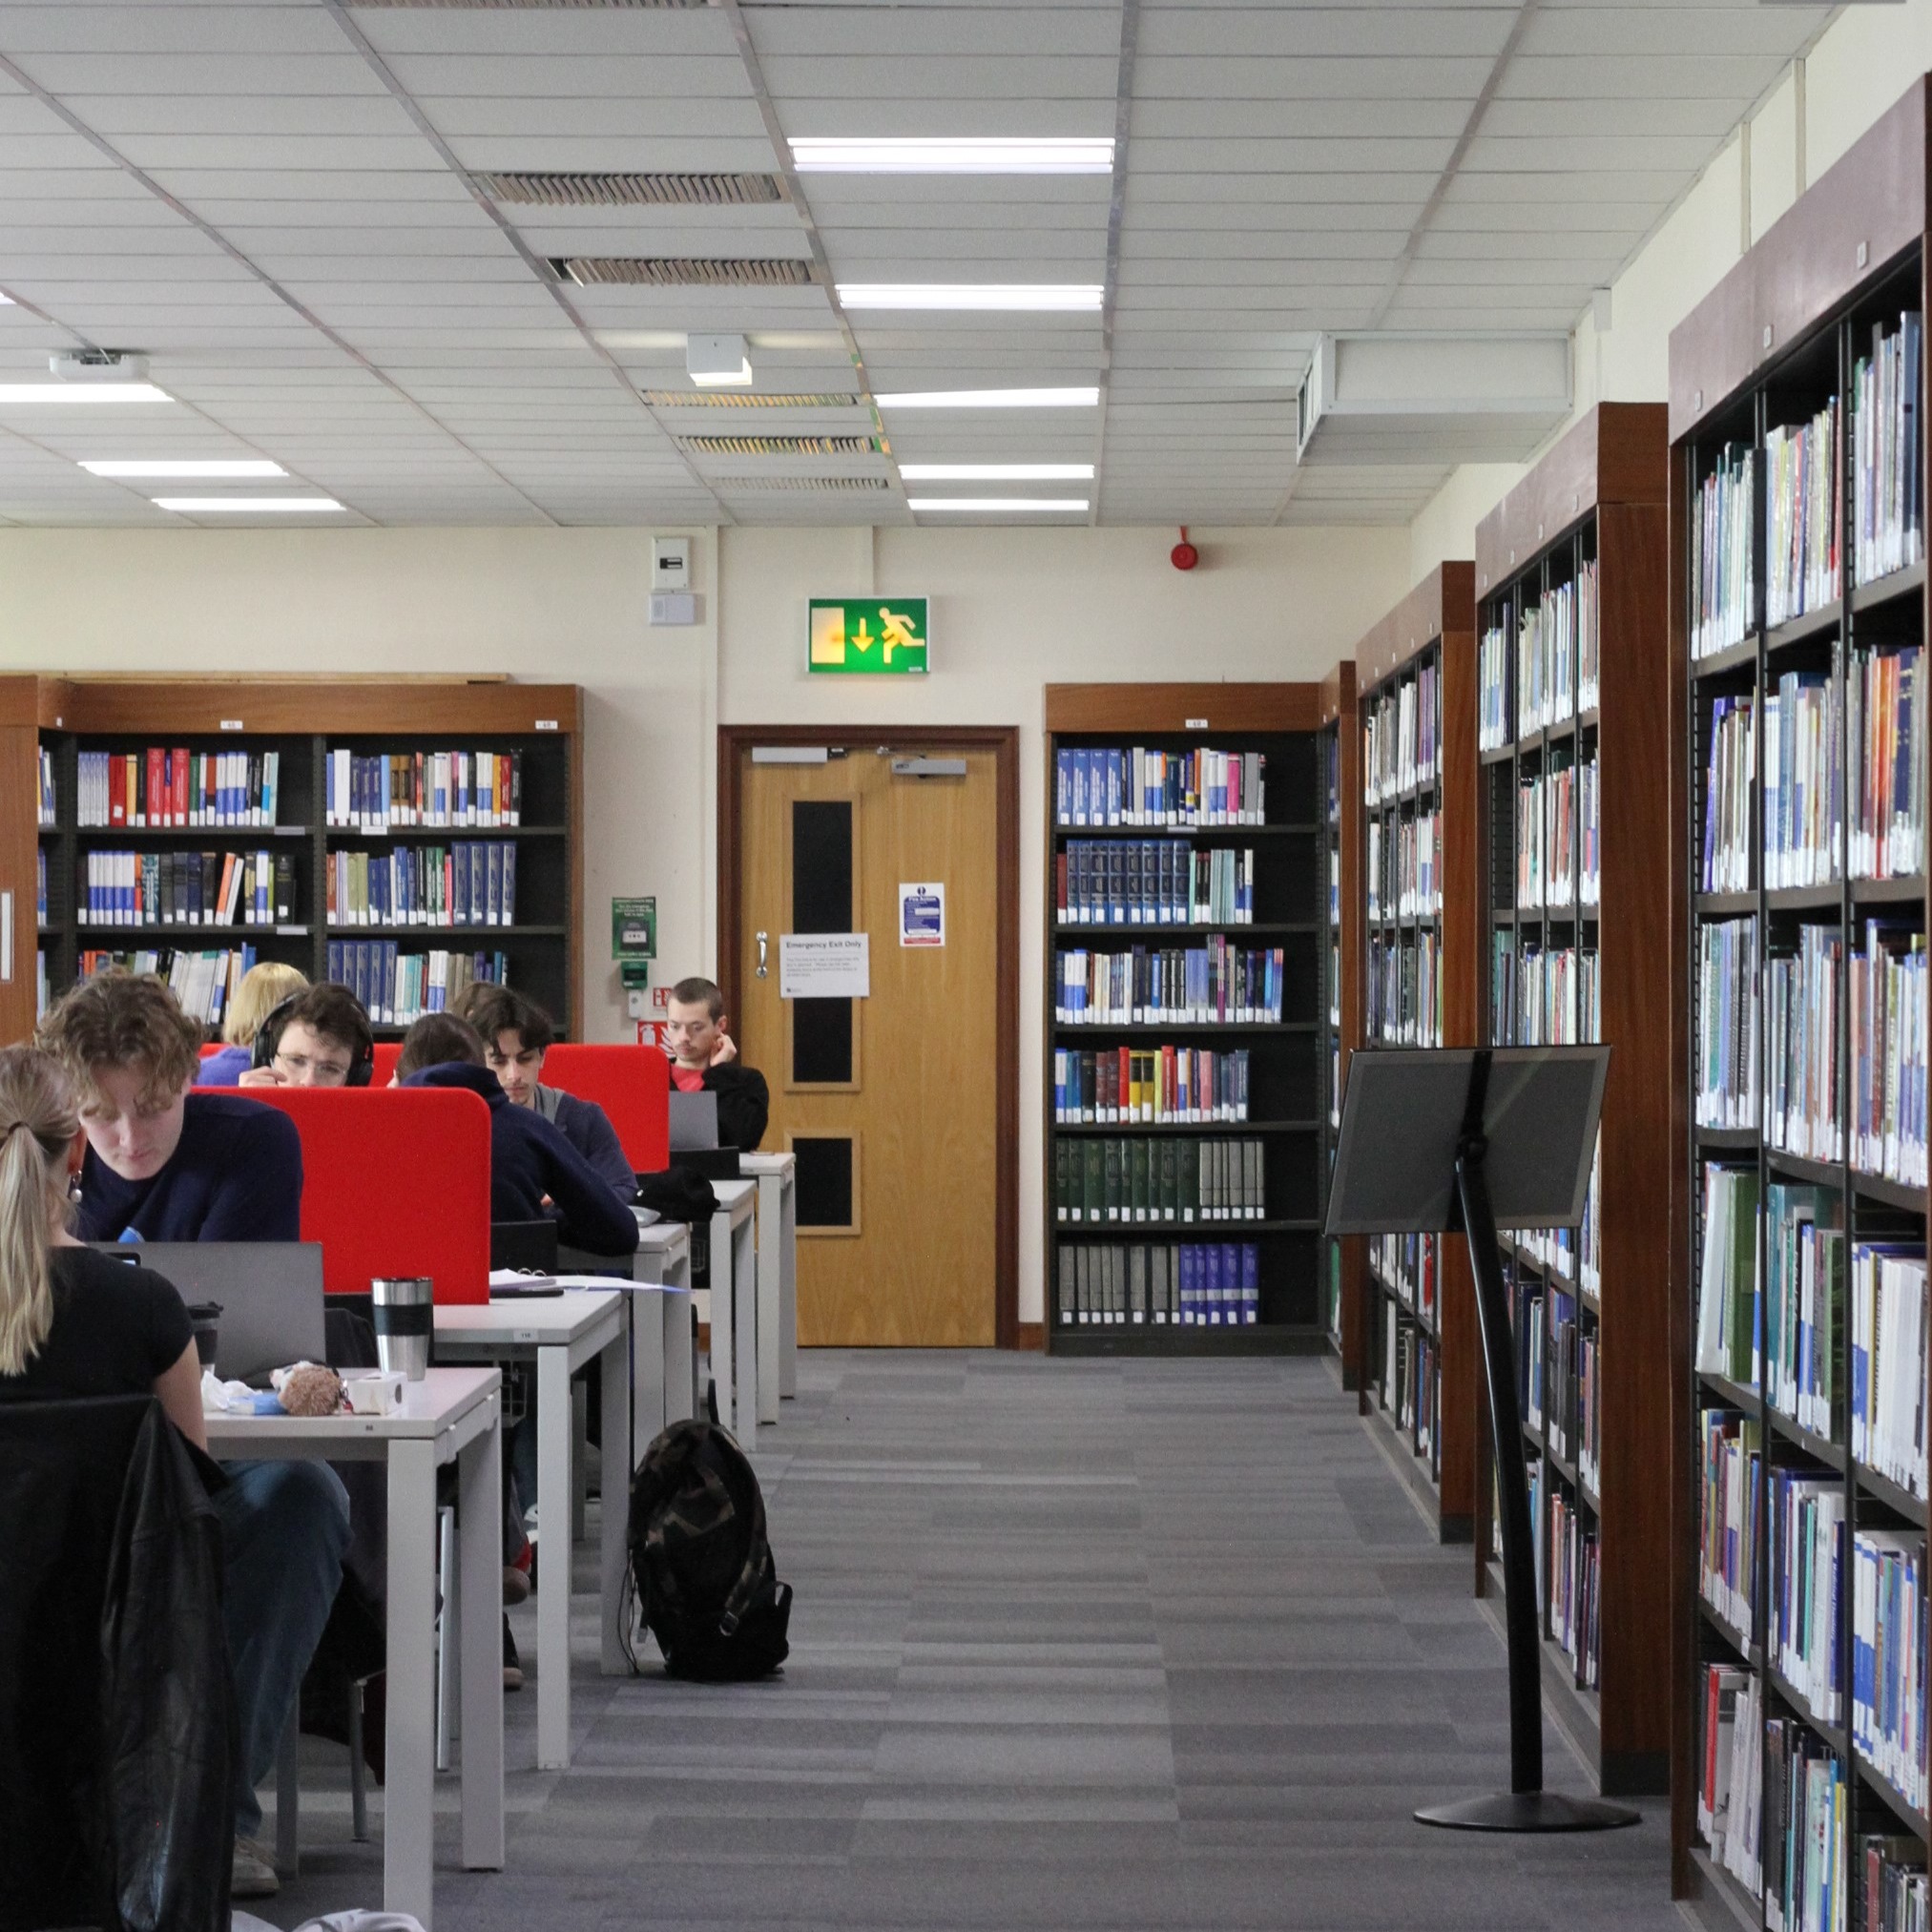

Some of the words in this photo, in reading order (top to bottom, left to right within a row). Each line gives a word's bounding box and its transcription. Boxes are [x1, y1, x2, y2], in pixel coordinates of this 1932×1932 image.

[786, 941, 827, 949] Emergency
[828, 940, 842, 948] Exit
[844, 940, 862, 948] Only
